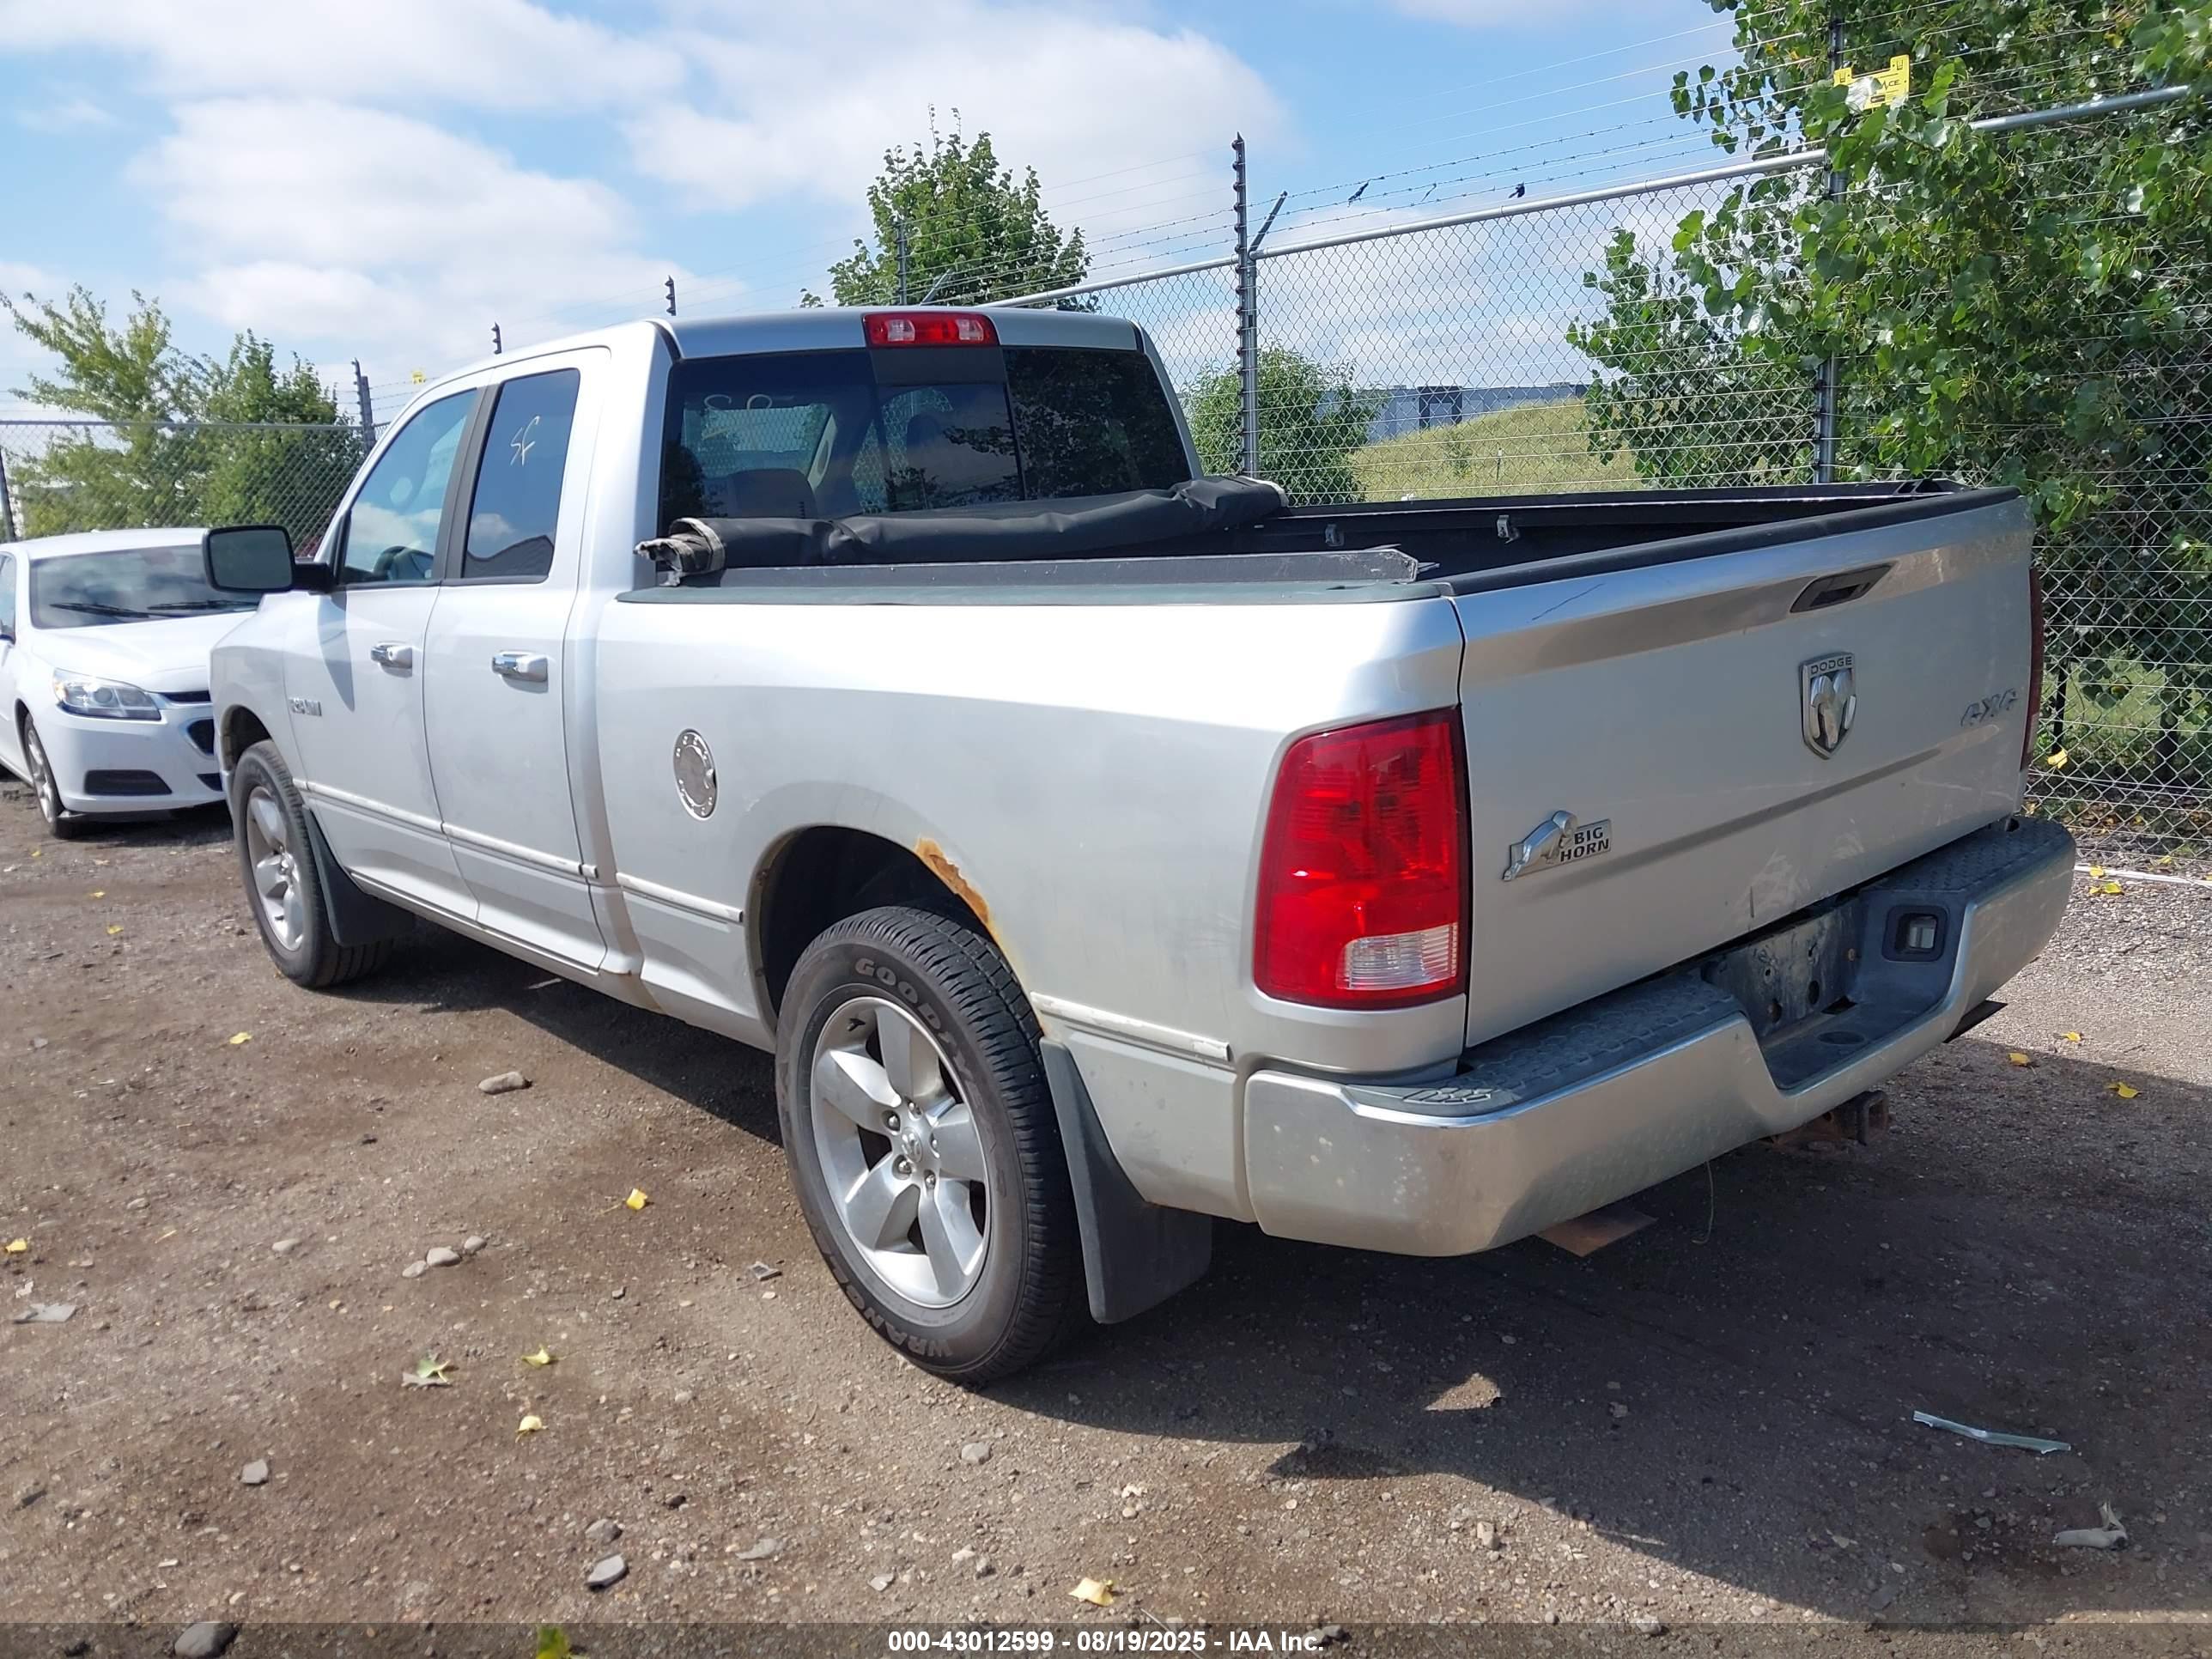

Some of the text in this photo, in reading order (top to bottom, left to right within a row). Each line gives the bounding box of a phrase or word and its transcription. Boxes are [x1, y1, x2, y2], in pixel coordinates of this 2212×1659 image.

[1810, 655, 1853, 675] DODGE
[1573, 827, 1604, 845] BIG
[1559, 838, 1610, 863] HORN
